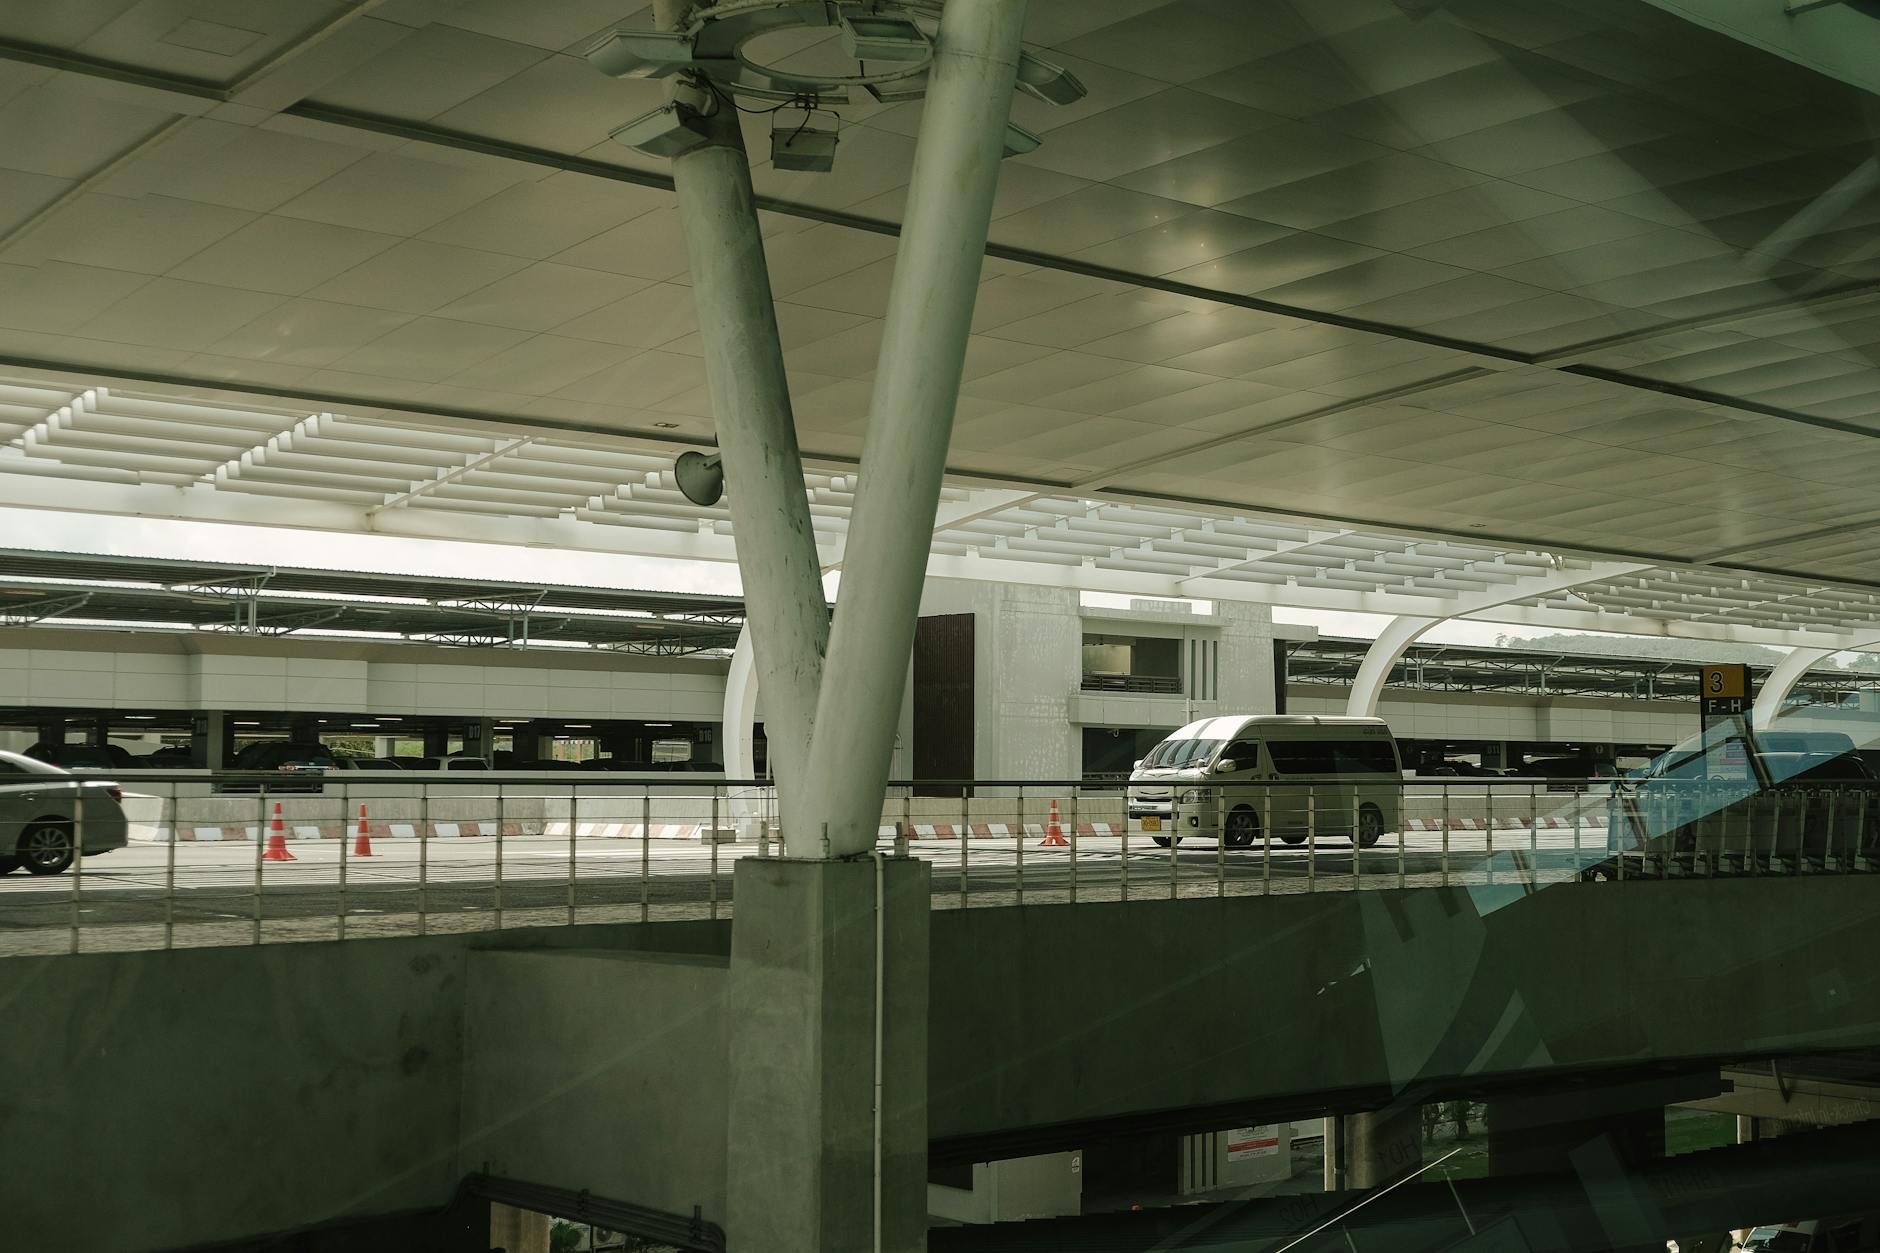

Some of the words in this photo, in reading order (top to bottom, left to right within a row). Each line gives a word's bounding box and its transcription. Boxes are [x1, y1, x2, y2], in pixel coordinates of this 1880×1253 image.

[1710, 671, 1724, 694] 3
[1708, 699, 1717, 713] F
[1730, 699, 1742, 713] H
